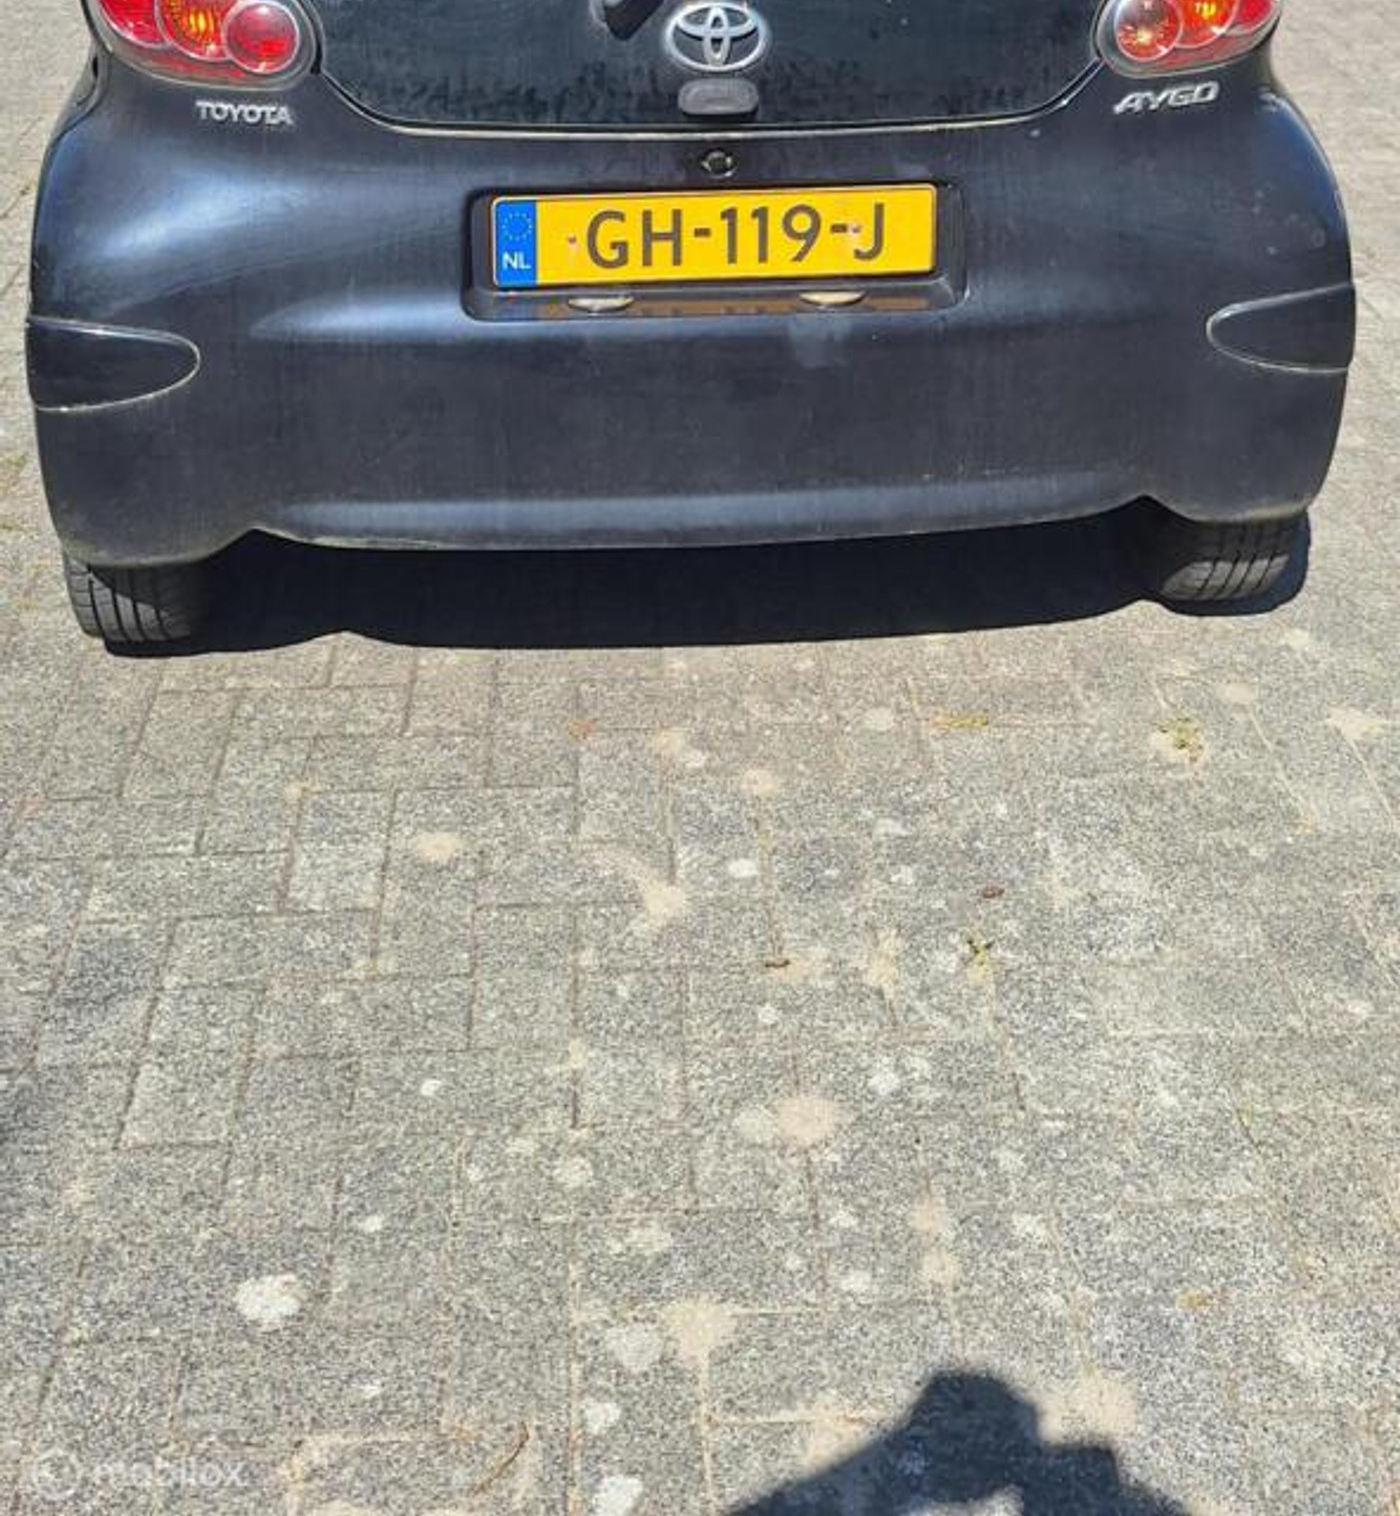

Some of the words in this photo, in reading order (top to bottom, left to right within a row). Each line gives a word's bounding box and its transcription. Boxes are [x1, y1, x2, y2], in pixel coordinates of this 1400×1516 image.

[195, 100, 295, 125] TOYOTA
[1113, 81, 1220, 115] AYGO
[586, 202, 886, 269] GH-119-J
[502, 251, 532, 270] NL
